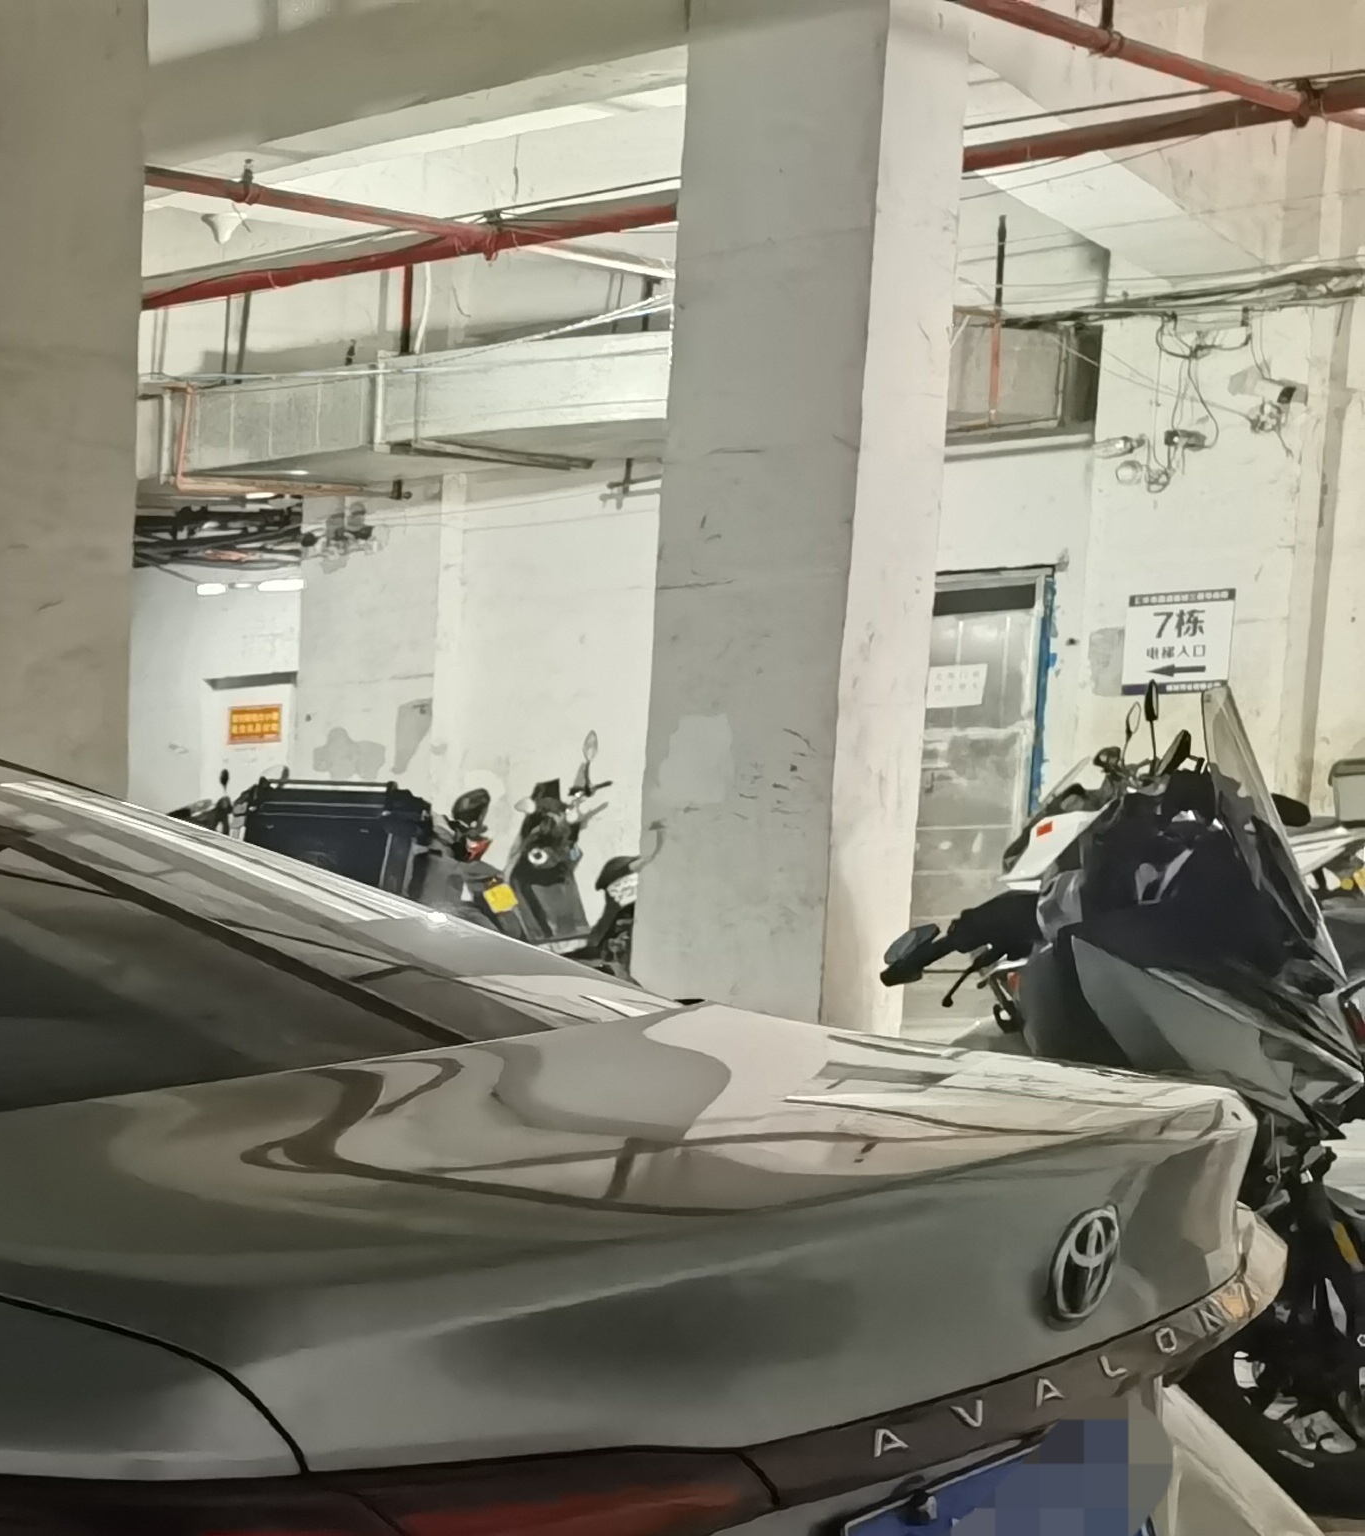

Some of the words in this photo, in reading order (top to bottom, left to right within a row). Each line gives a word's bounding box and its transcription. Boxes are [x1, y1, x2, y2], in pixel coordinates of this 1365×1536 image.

[1153, 609, 1206, 639] 7栋
[1146, 645, 1206, 660] 电梯入口
[873, 1298, 1233, 1458] AVALON
